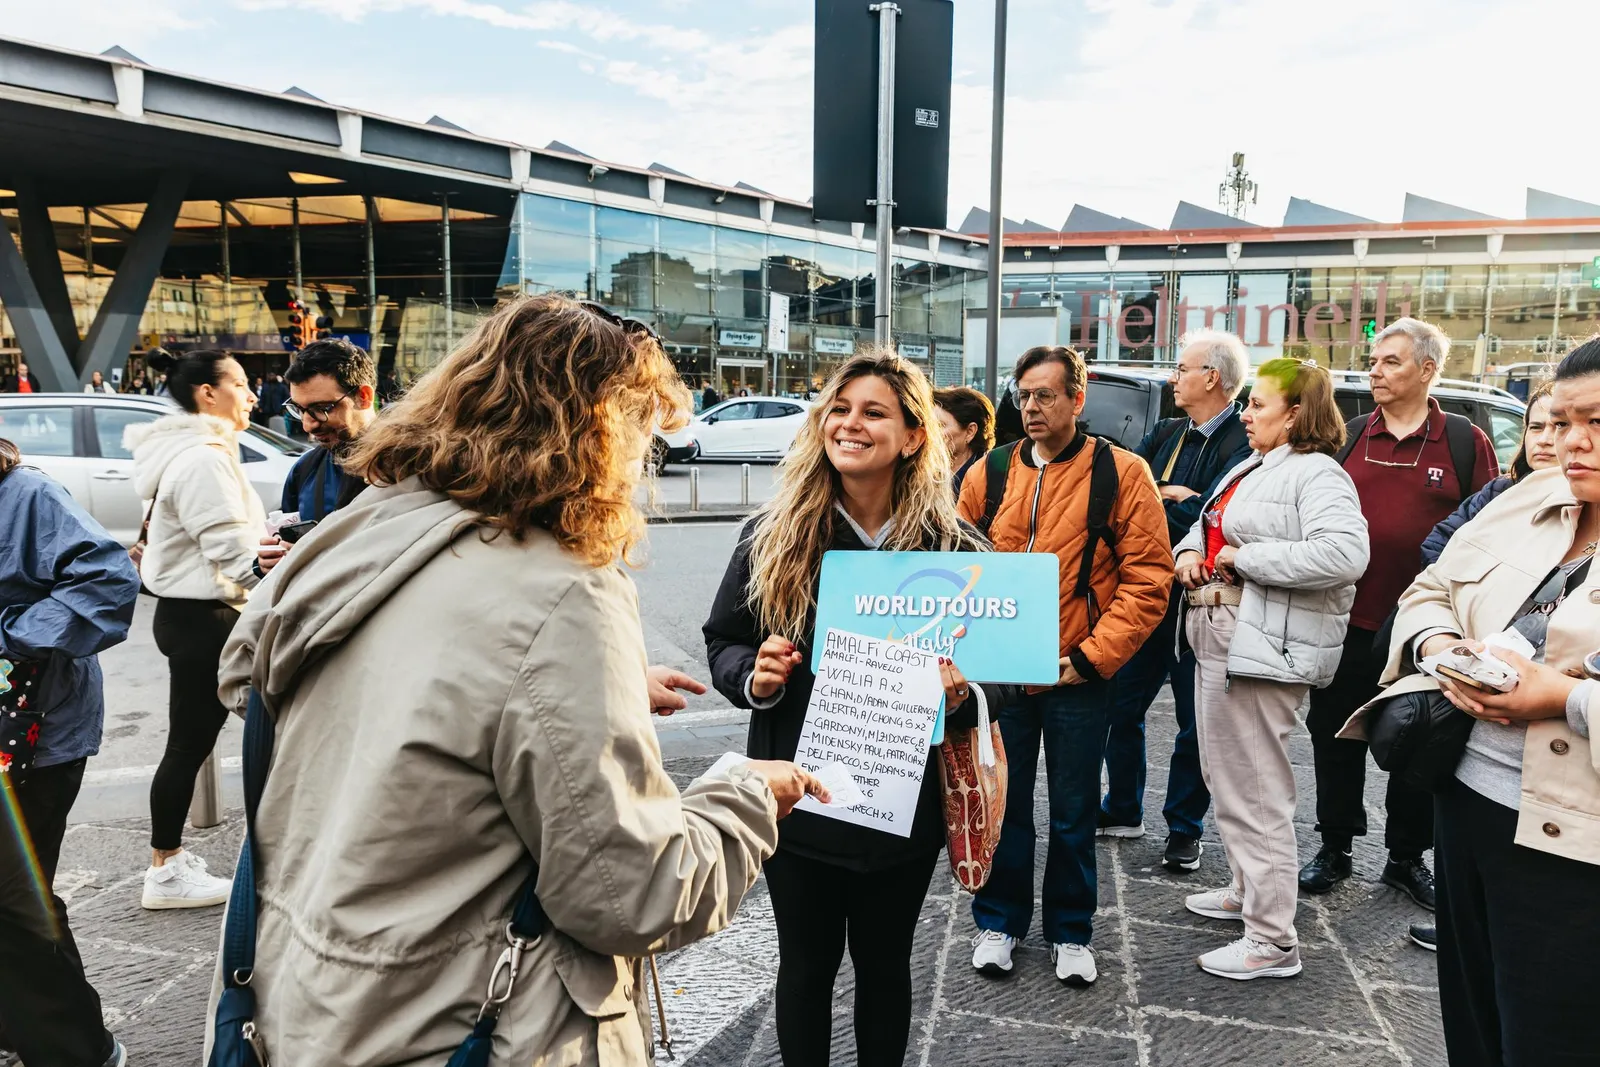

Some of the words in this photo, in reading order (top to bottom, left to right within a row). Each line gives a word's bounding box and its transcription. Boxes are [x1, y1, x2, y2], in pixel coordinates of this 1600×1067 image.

[1077, 282, 1412, 349] Feltrinelli
[854, 594, 1018, 619] WORLDTOURS
[885, 644, 934, 668] COAST
[850, 774, 881, 788] ATHER
[881, 811, 894, 823] x2
